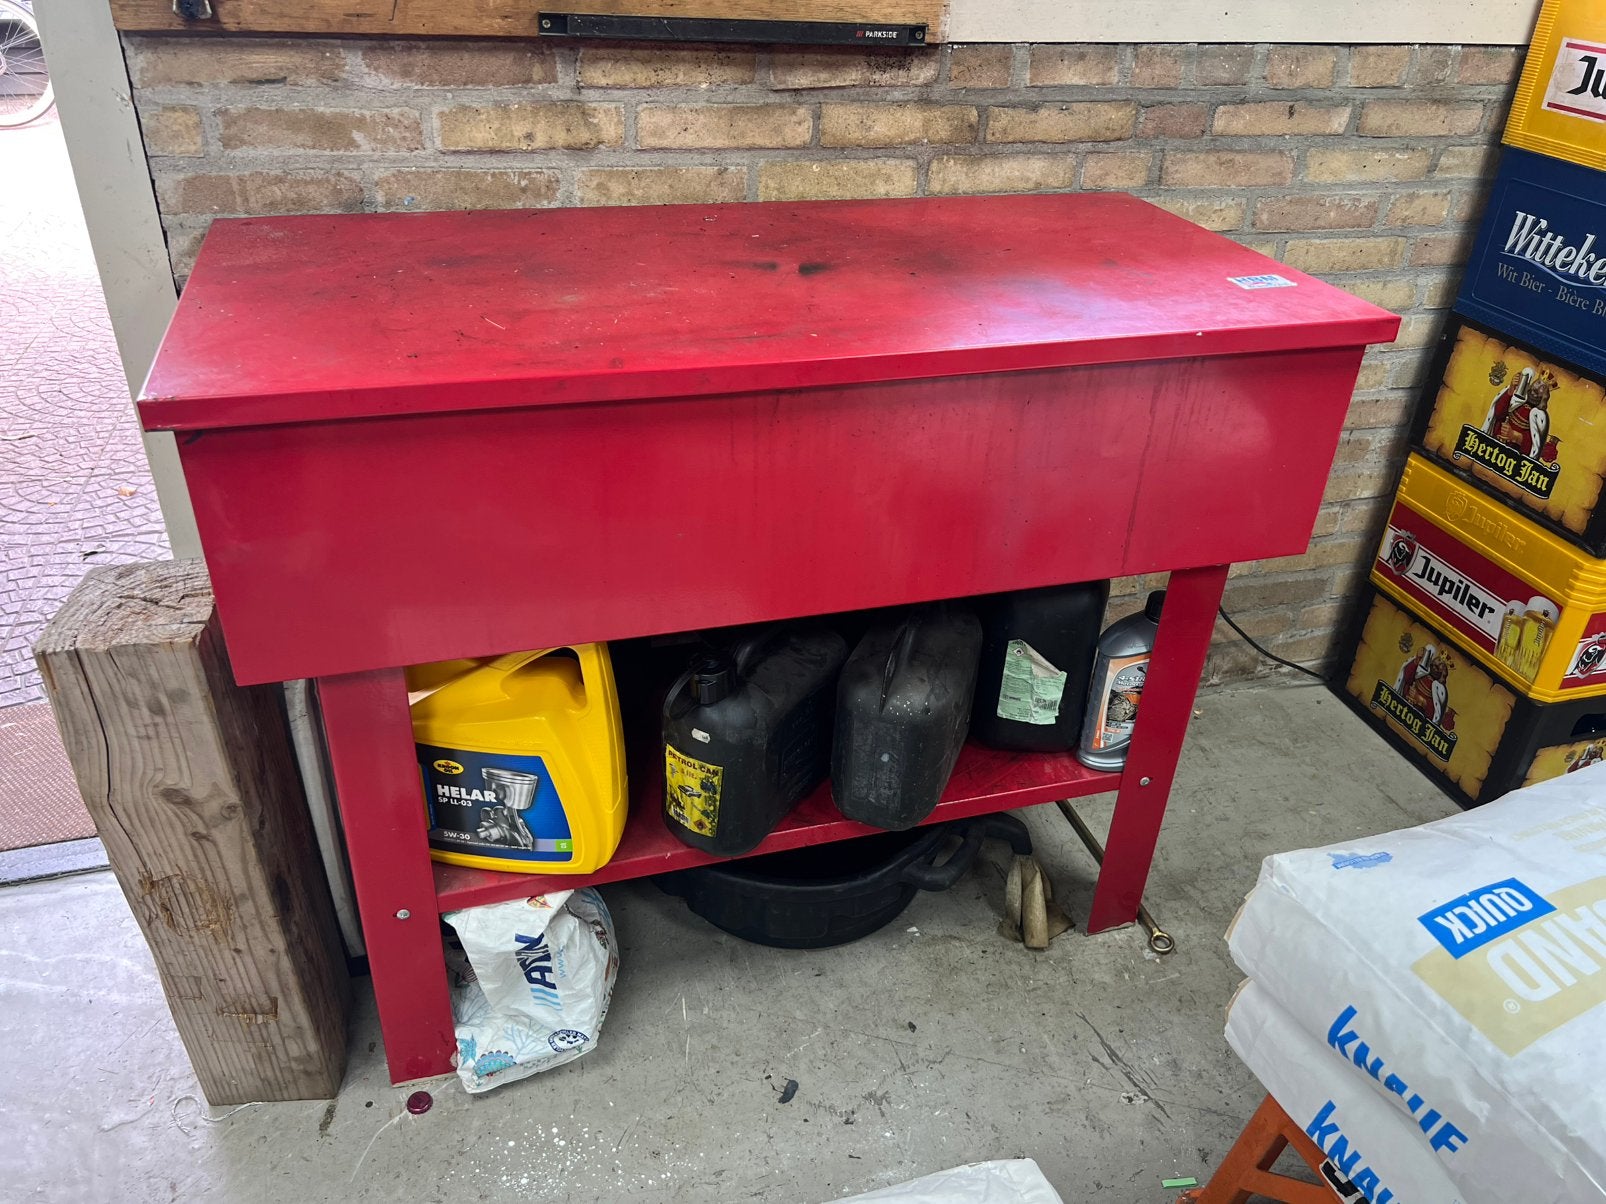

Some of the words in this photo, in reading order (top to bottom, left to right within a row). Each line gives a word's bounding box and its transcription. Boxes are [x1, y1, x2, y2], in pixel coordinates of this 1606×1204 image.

[865, 30, 898, 39] PARKSIDE
[1504, 210, 1606, 287] Witteke
[1498, 262, 1519, 283] Wit
[1519, 271, 1546, 293] Bier
[1556, 285, 1590, 310] Bière
[1462, 430, 1517, 475] Hertog
[1515, 461, 1549, 491] Jan
[1464, 502, 1527, 553] Jupiler
[1412, 554, 1496, 620] Jupiler
[1378, 685, 1423, 736] Hertog
[1421, 720, 1449, 756] Jan
[668, 750, 698, 770] PETROL
[700, 764, 719, 777] CAN
[436, 784, 497, 803] HELAR
[450, 798, 472, 807] LL-03
[443, 830, 471, 840] 5W-30
[1433, 887, 1534, 945] QUICK
